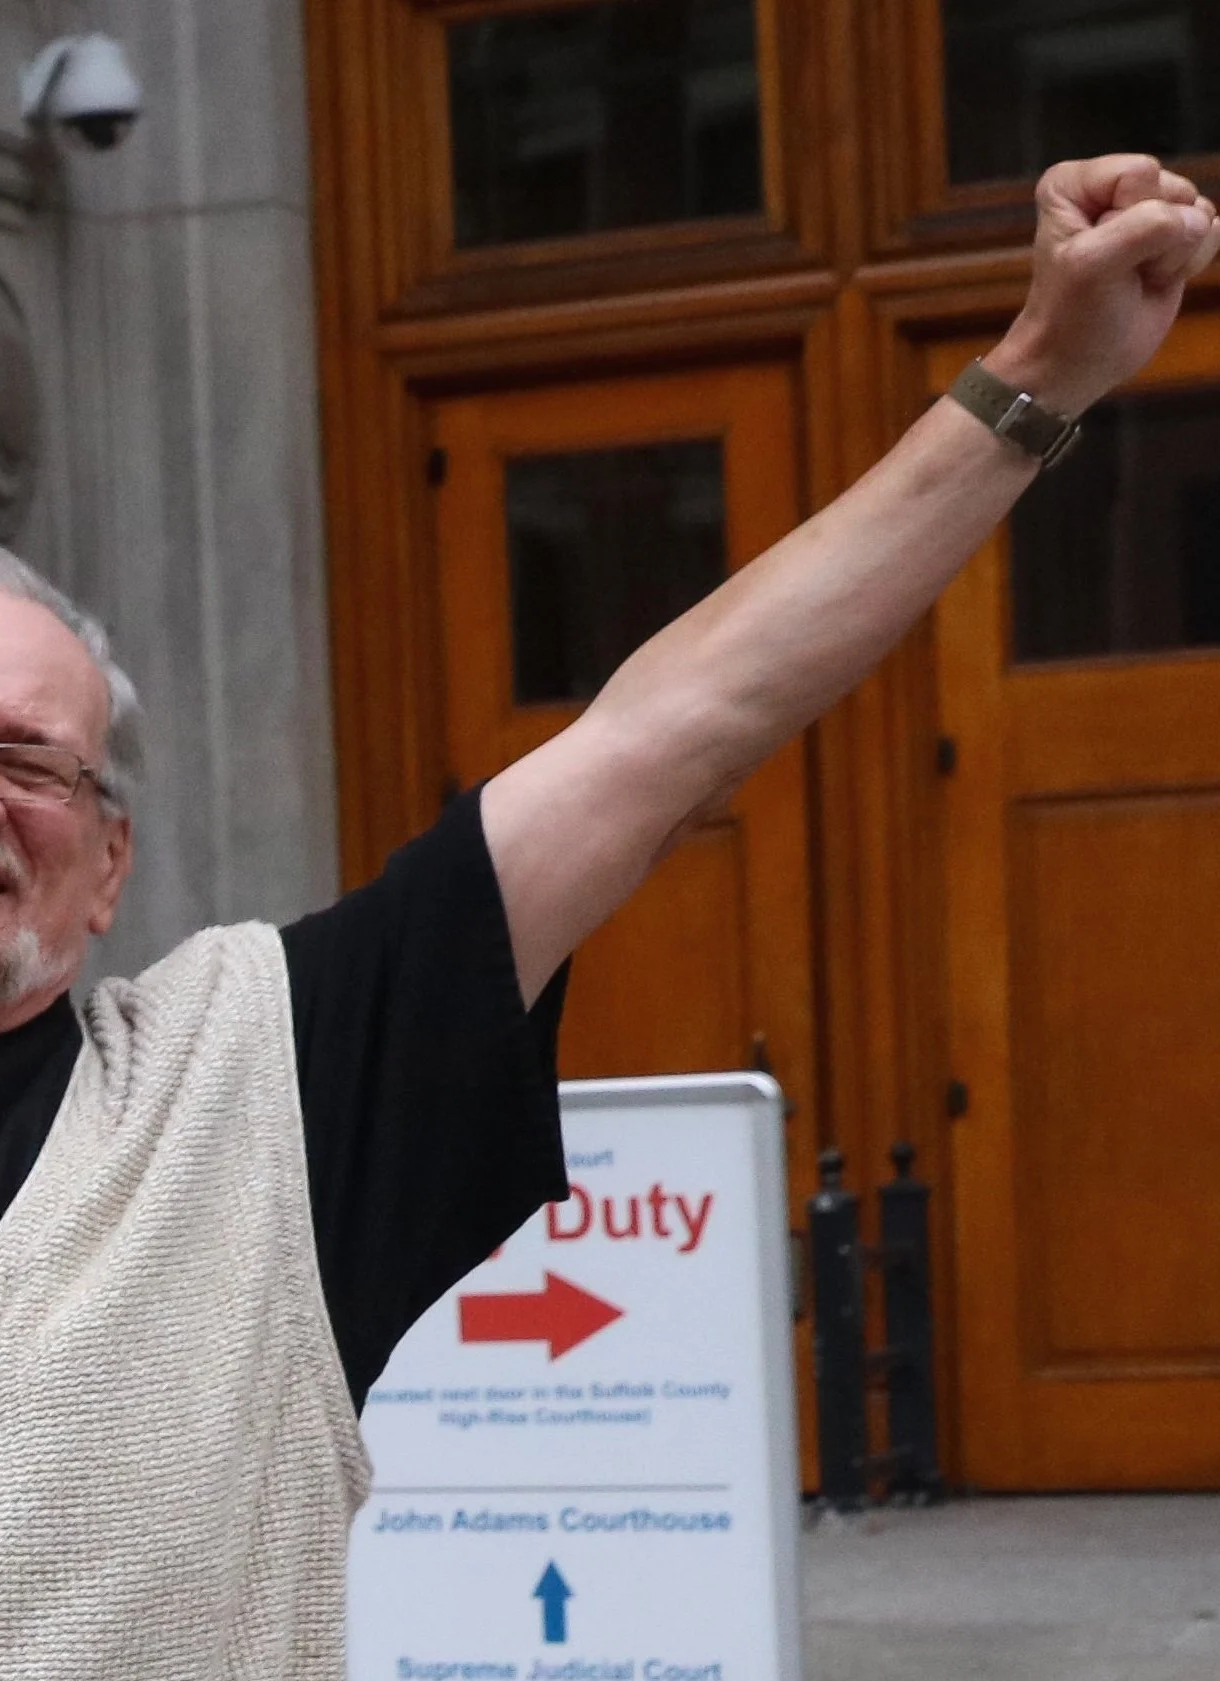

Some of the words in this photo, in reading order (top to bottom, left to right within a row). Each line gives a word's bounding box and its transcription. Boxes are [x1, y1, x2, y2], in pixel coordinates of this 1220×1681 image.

[568, 1148, 614, 1169] ourt
[546, 1182, 715, 1255] Duty
[589, 1380, 656, 1399] Suffolk
[662, 1379, 731, 1400] County
[373, 1509, 444, 1534] John
[451, 1508, 549, 1533] Adams
[558, 1506, 732, 1533] Courthouse
